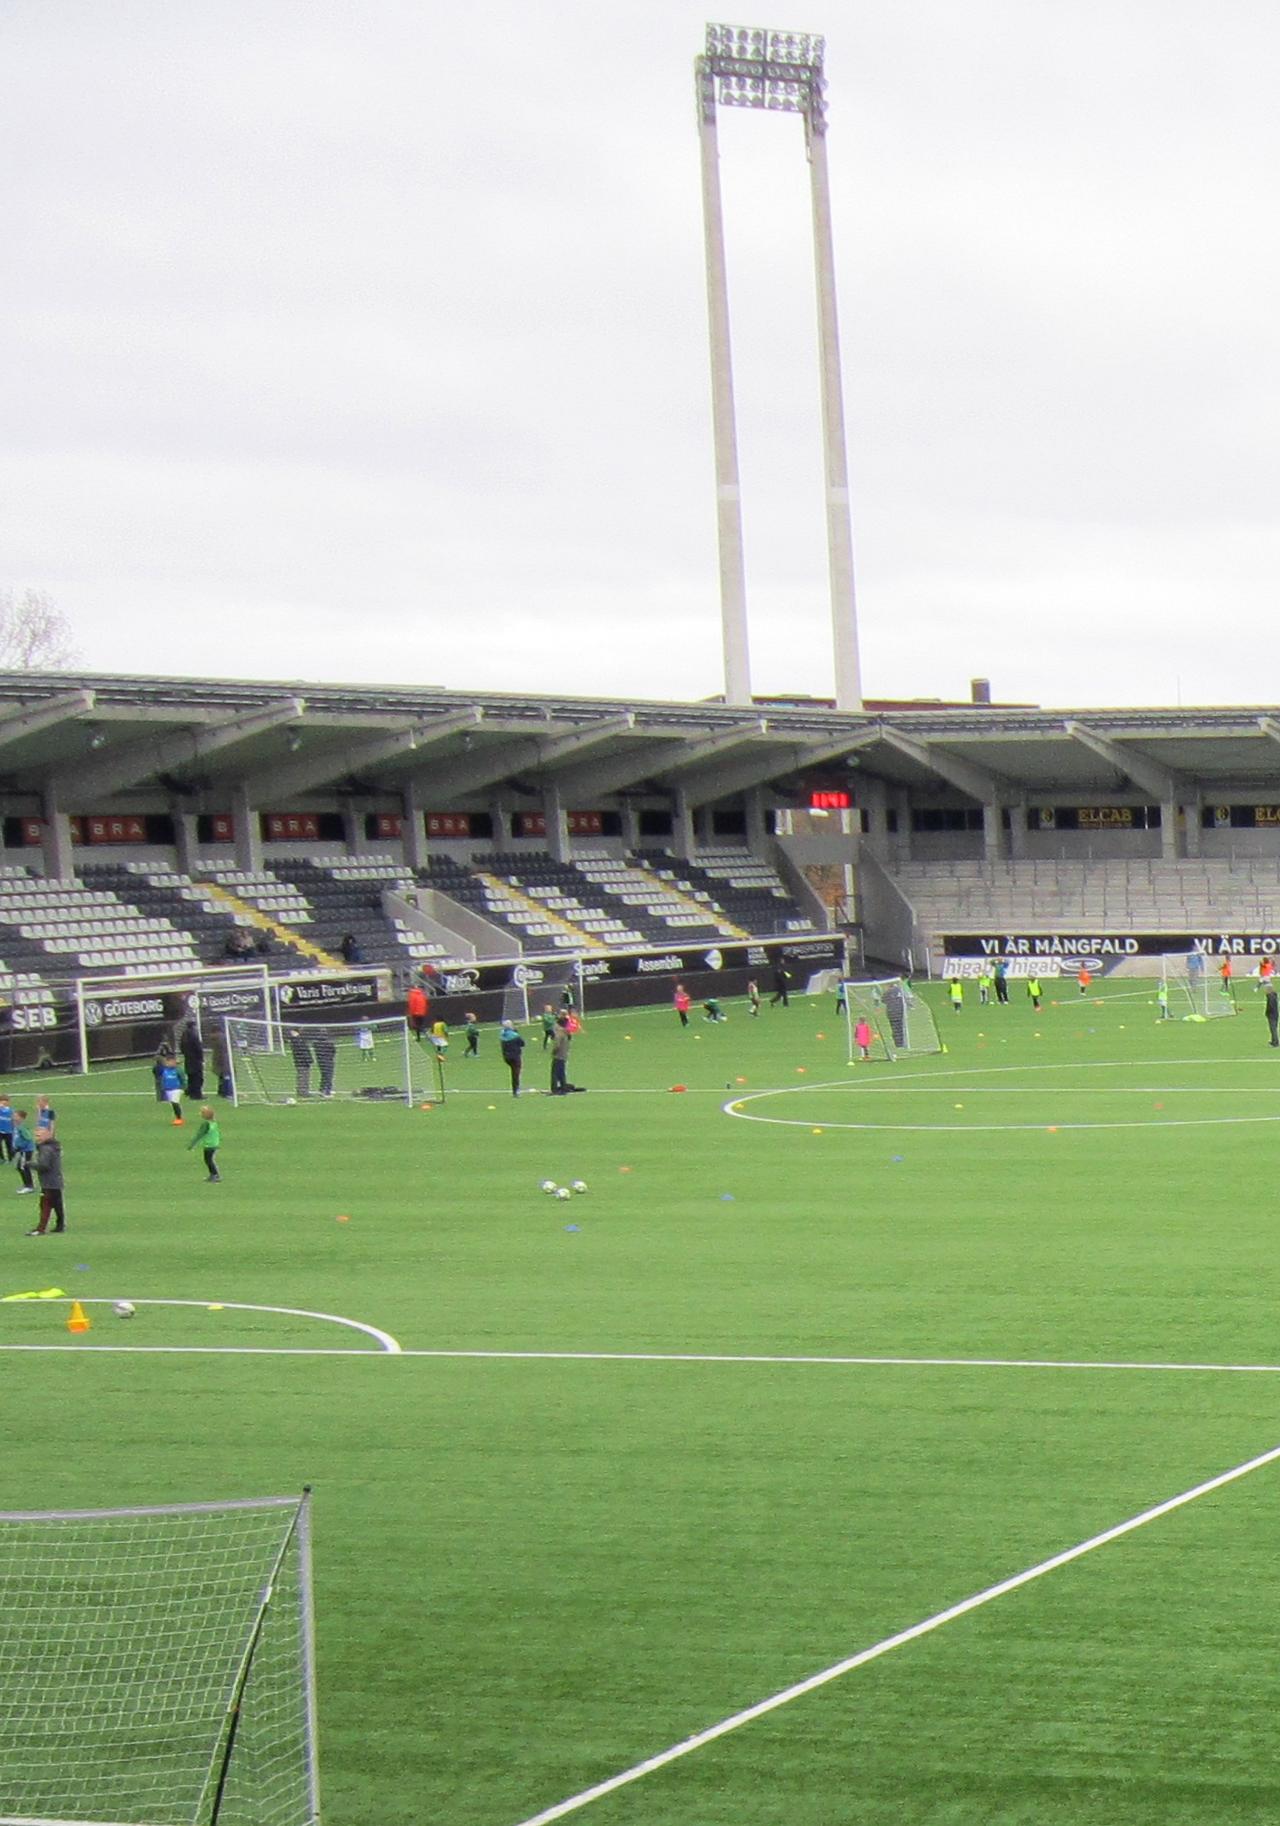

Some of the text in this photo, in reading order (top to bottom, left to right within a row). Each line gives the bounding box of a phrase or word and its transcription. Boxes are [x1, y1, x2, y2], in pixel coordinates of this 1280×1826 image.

[272, 817, 316, 831] BRA
[431, 818, 469, 830] BRA
[1078, 808, 1132, 822] ELCAB
[93, 824, 142, 834] BRA
[981, 935, 1139, 954] VI ÄR MÅNGFALD
[1194, 938, 1213, 954] VI
[1218, 935, 1245, 954] ÄR
[637, 954, 684, 972] Assemblin
[1012, 956, 1060, 977] higab
[104, 999, 164, 1017] GÖTEBORG
[12, 1007, 57, 1030] SEB
